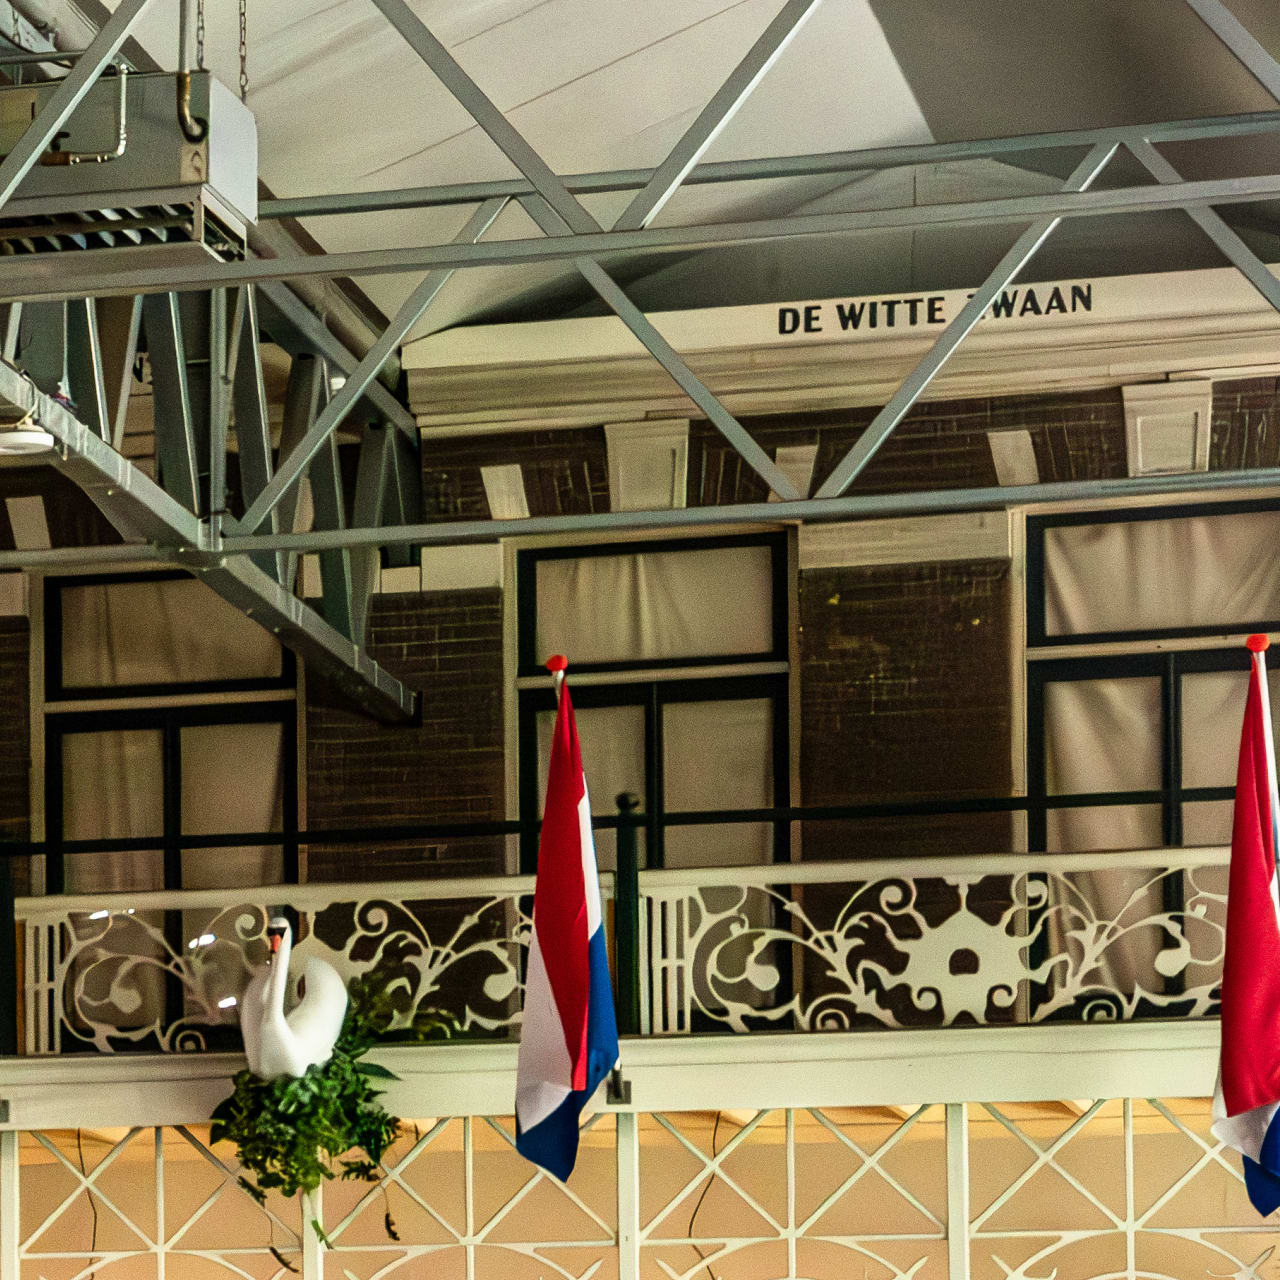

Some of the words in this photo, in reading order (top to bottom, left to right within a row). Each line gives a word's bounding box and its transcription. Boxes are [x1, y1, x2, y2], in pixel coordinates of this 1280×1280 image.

[778, 305, 822, 334] DE
[837, 296, 946, 331] WITTE
[967, 284, 1092, 319] WAAN
